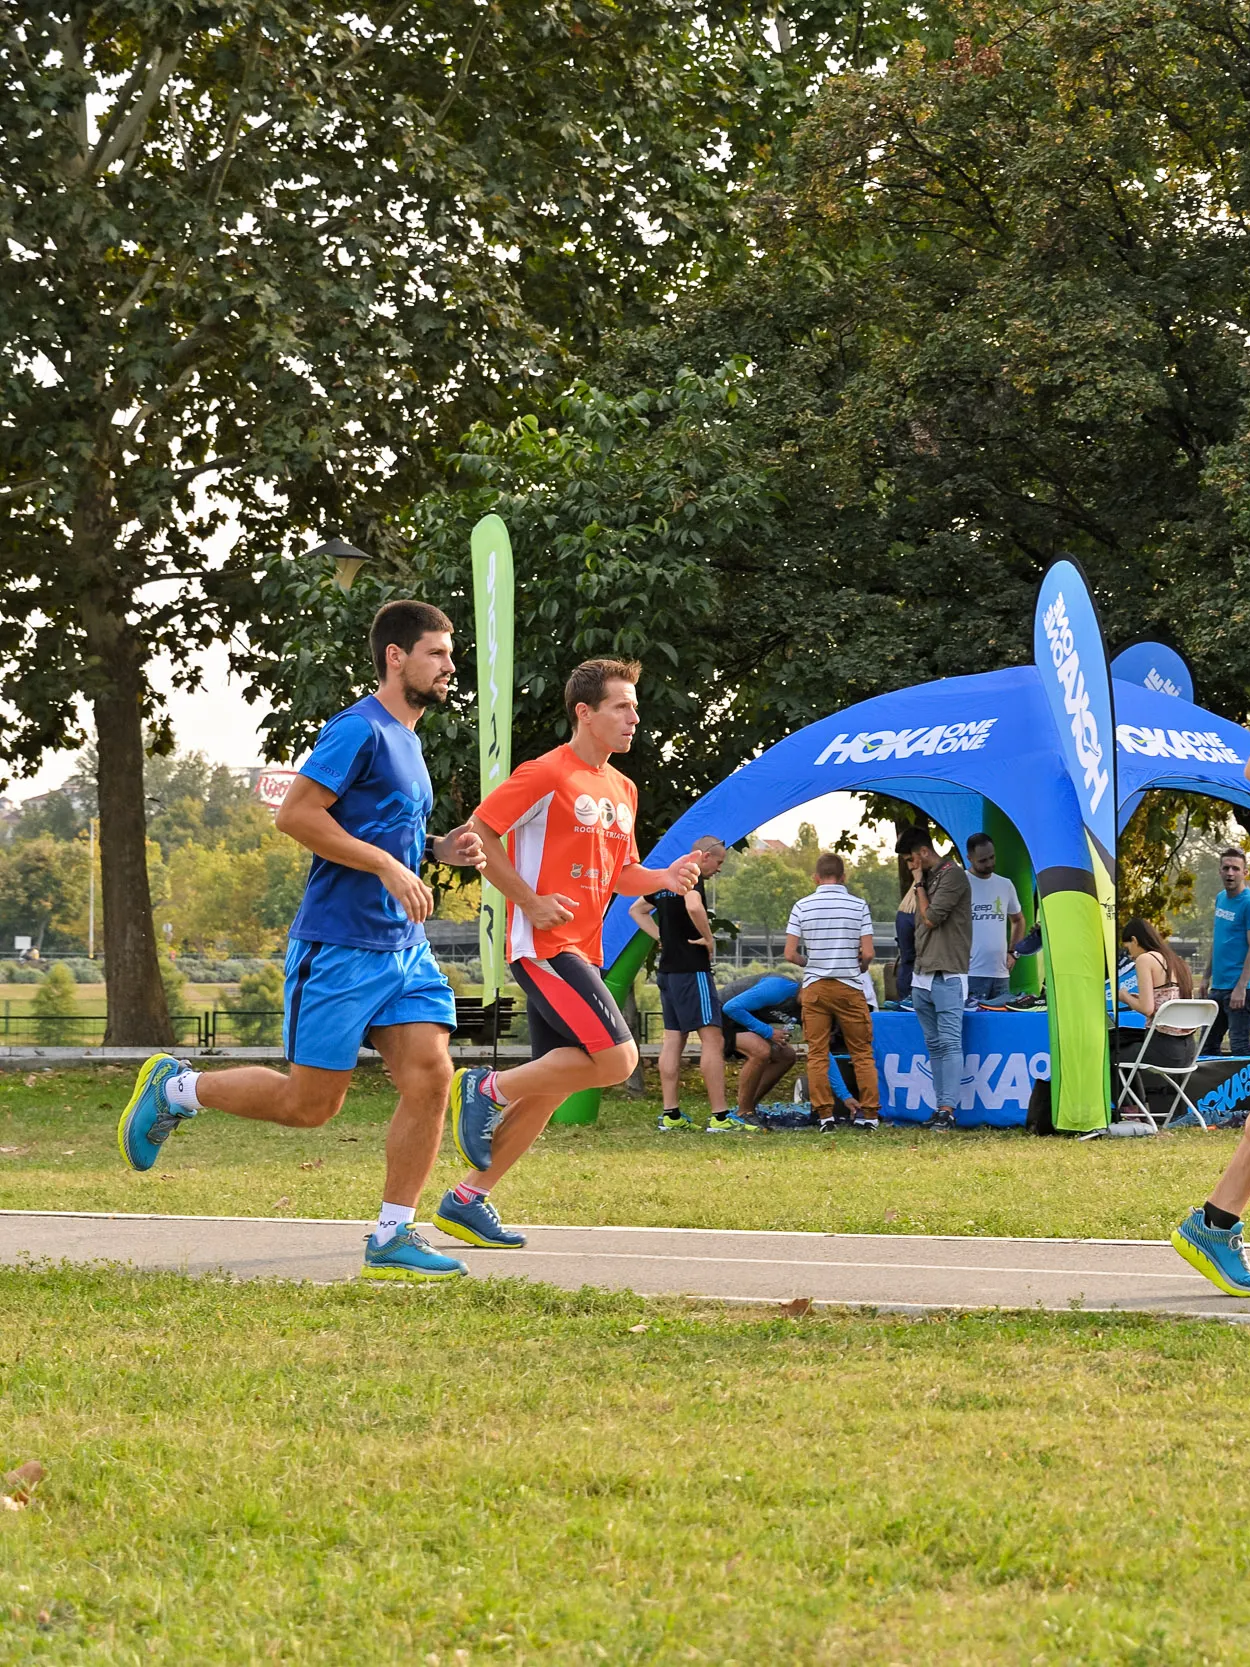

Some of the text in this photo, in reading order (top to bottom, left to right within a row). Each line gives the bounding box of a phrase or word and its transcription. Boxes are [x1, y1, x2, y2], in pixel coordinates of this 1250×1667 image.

[813, 717, 999, 766] HOKA ONE
[936, 733, 991, 755] ONE
[1181, 730, 1226, 749] ONE
[1200, 747, 1243, 765] ONE
[465, 1074, 477, 1104] HOKA
